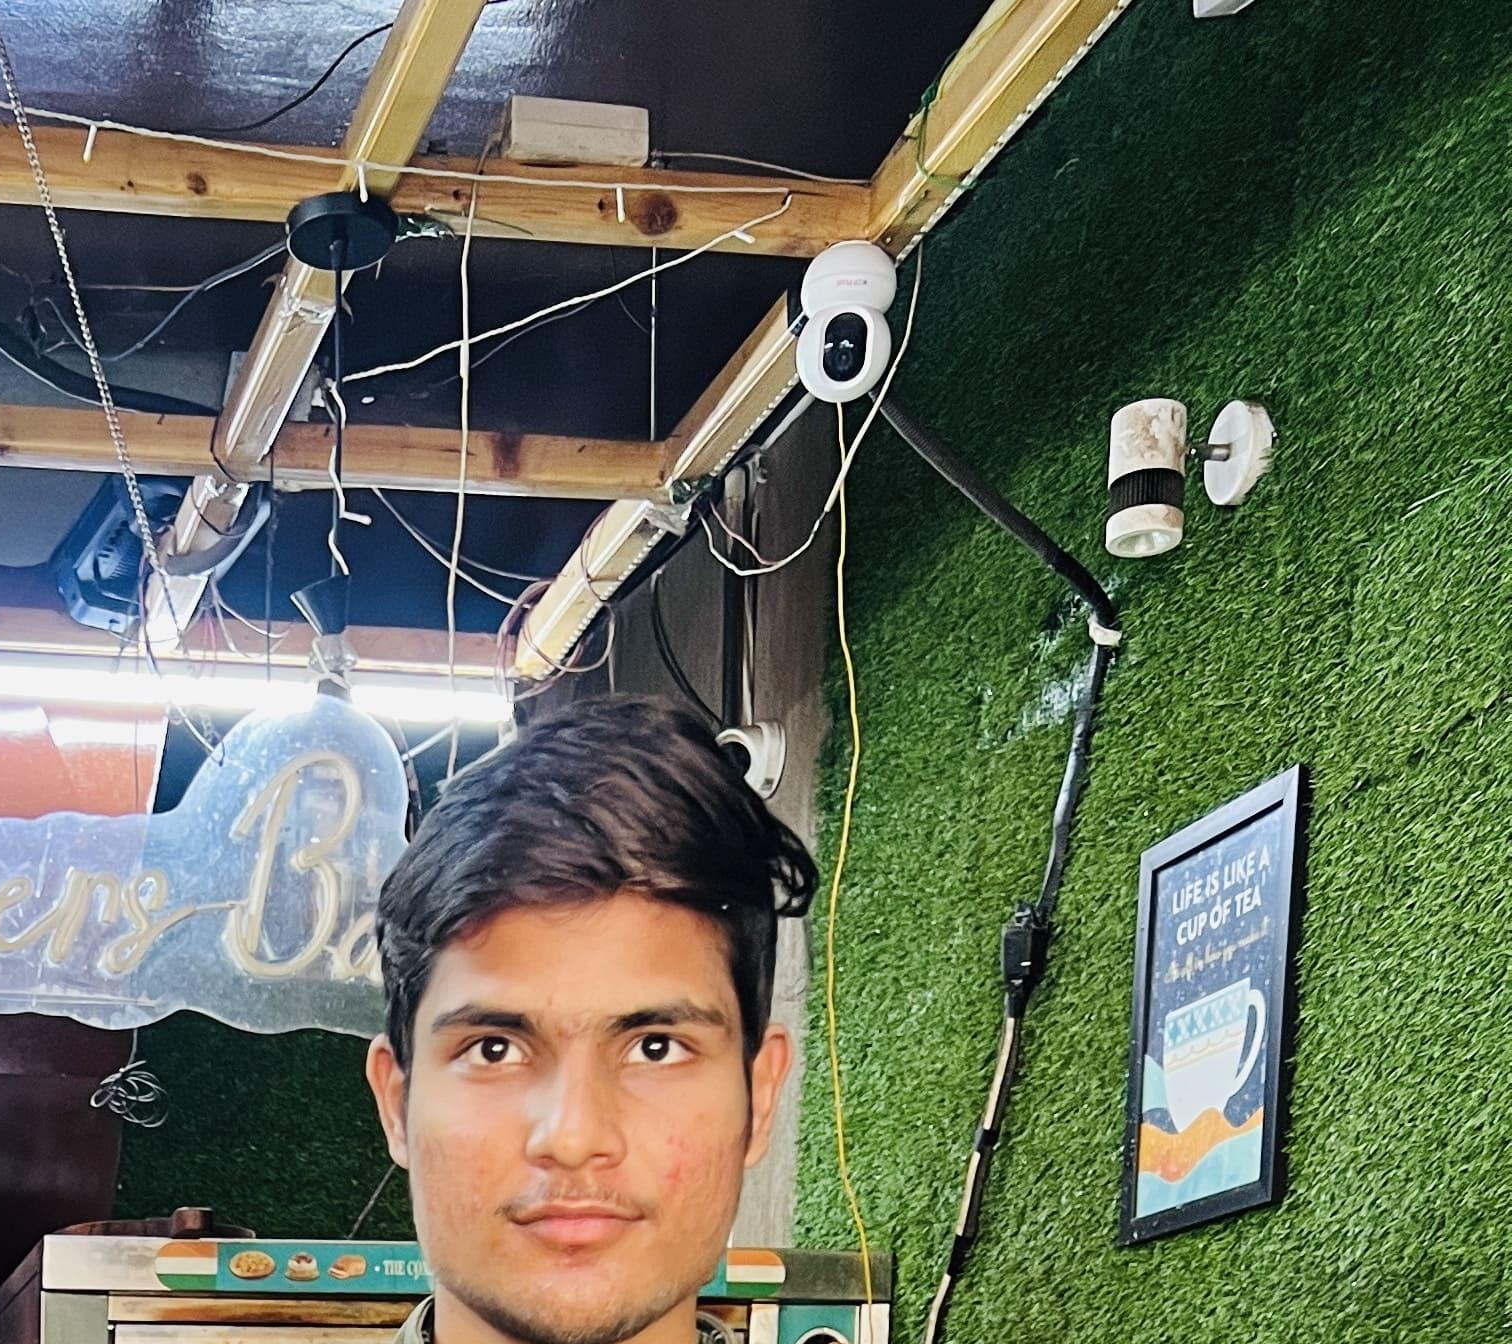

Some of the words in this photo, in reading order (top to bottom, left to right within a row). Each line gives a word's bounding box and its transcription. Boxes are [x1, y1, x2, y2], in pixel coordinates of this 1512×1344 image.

[1172, 879, 1204, 915] LIFE
[1205, 870, 1219, 897] IS
[1224, 851, 1256, 890] LIKE
[1258, 845, 1270, 871] A
[1176, 911, 1208, 946] CUP
[1210, 898, 1232, 930] OF
[1235, 885, 1262, 918] TEA
